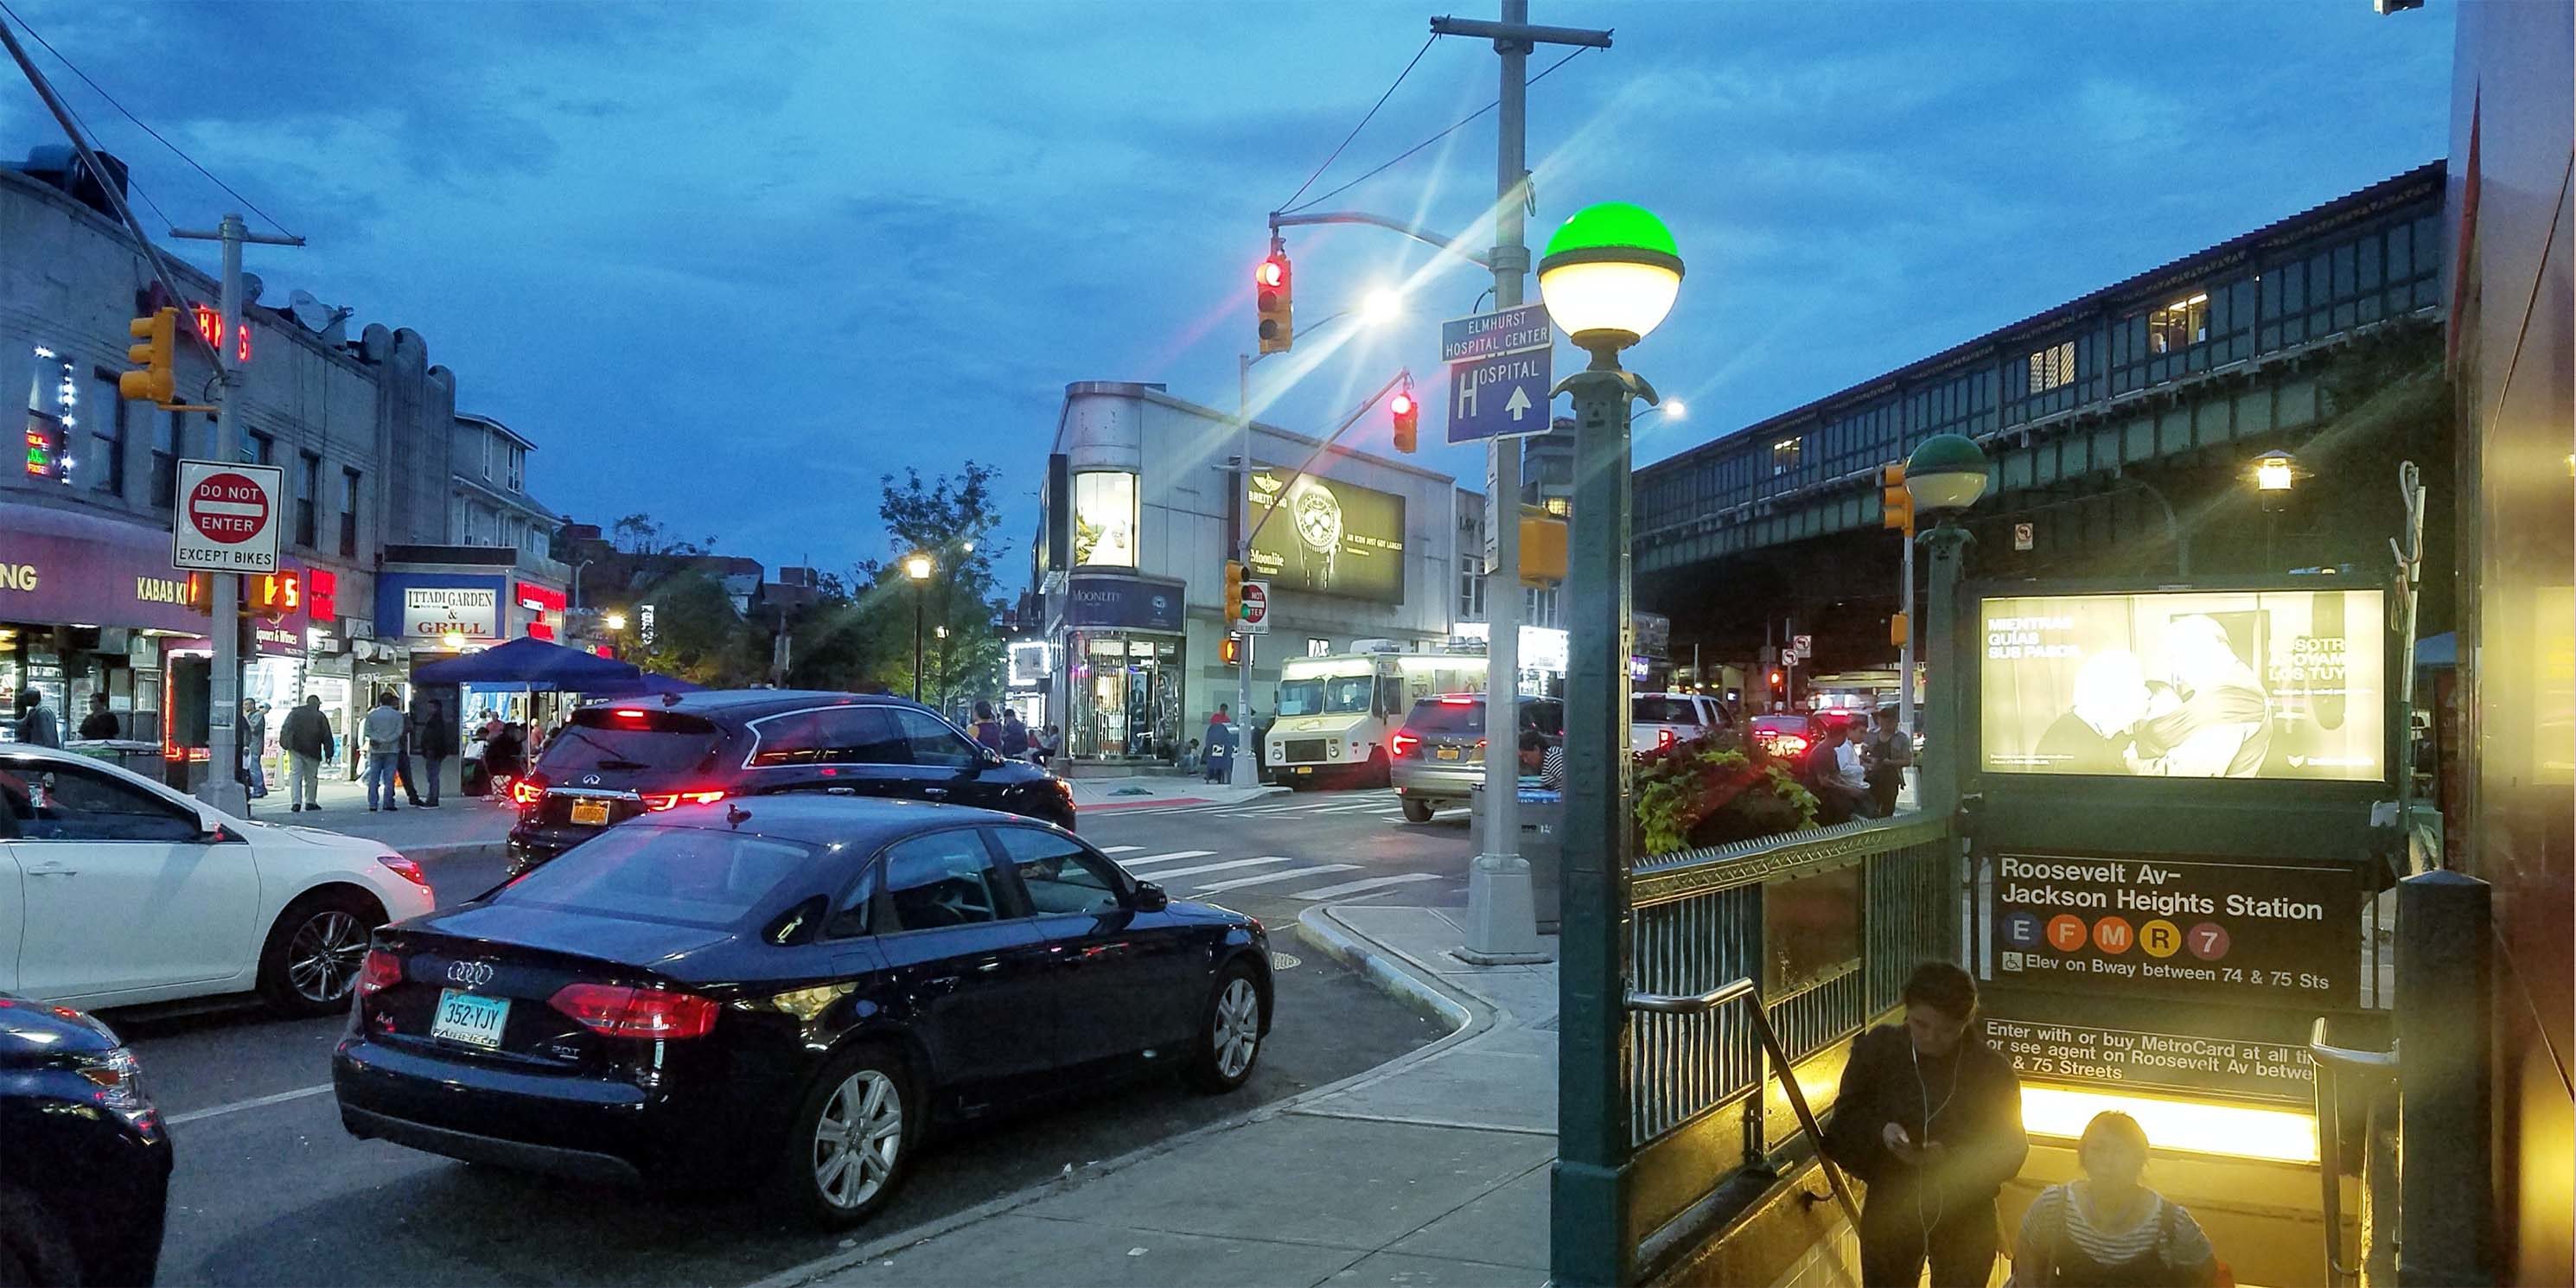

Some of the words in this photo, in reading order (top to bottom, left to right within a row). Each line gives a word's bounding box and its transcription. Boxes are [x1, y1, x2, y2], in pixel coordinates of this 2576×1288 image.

[1469, 311, 1527, 334] ELMHURST
[1446, 338, 1499, 357] HOSPITAL
[1506, 328, 1548, 348] CENTER
[1457, 360, 1540, 419] HOSPITAL
[201, 484, 221, 498] DO
[228, 487, 259, 501] NOT
[201, 517, 254, 532] ENTER
[1459, 517, 1476, 532] LAW
[179, 548, 229, 563] EXCEPT
[234, 552, 271, 565] BIKES
[1250, 548, 1285, 567] Moonlite
[137, 577, 174, 603] KABAB
[408, 590, 446, 608] ITTADI
[448, 591, 493, 608] GARDEN
[448, 609, 457, 620] &
[418, 622, 486, 634] GRILL
[2269, 666, 2305, 680] LOS
[2001, 857, 2126, 883] Roosevelt
[2002, 883, 2107, 908] Jackson
[2117, 889, 2214, 916] Heights
[2226, 894, 2323, 920] Station
[2014, 920, 2030, 941] E
[2059, 924, 2075, 942] F
[2102, 926, 2125, 946] M
[2152, 928, 2170, 950] R
[2201, 932, 2218, 953] 7
[2026, 953, 2059, 969] Elev
[2066, 960, 2086, 972] on
[2092, 959, 2135, 978] Bway
[2143, 962, 2216, 980] between
[2222, 967, 2242, 983] 74
[2251, 970, 2263, 985] &
[2270, 972, 2292, 986] 75
[2299, 972, 2329, 990] Sts
[1986, 1021, 2031, 1038] Enter
[2037, 1028, 2072, 1043] with
[2079, 1033, 2097, 1045] or
[2103, 1032, 2134, 1051] buy
[2141, 1036, 2235, 1058] MetroCard
[2242, 1046, 2260, 1061] at
[2267, 1048, 2288, 1062] all
[2296, 1049, 2311, 1065] ti
[1986, 1038, 2005, 1051] or
[2010, 1042, 2041, 1055] see
[2049, 1044, 2096, 1060] agent
[2103, 1049, 2125, 1062] on
[2132, 1049, 2220, 1072] Roosevelt
[2227, 1059, 2249, 1074] Av
[2256, 1062, 2313, 1081] betwe
[2013, 1055, 2024, 1070] &
[2031, 1056, 2053, 1073] 75
[2059, 1060, 2123, 1080] Streets
